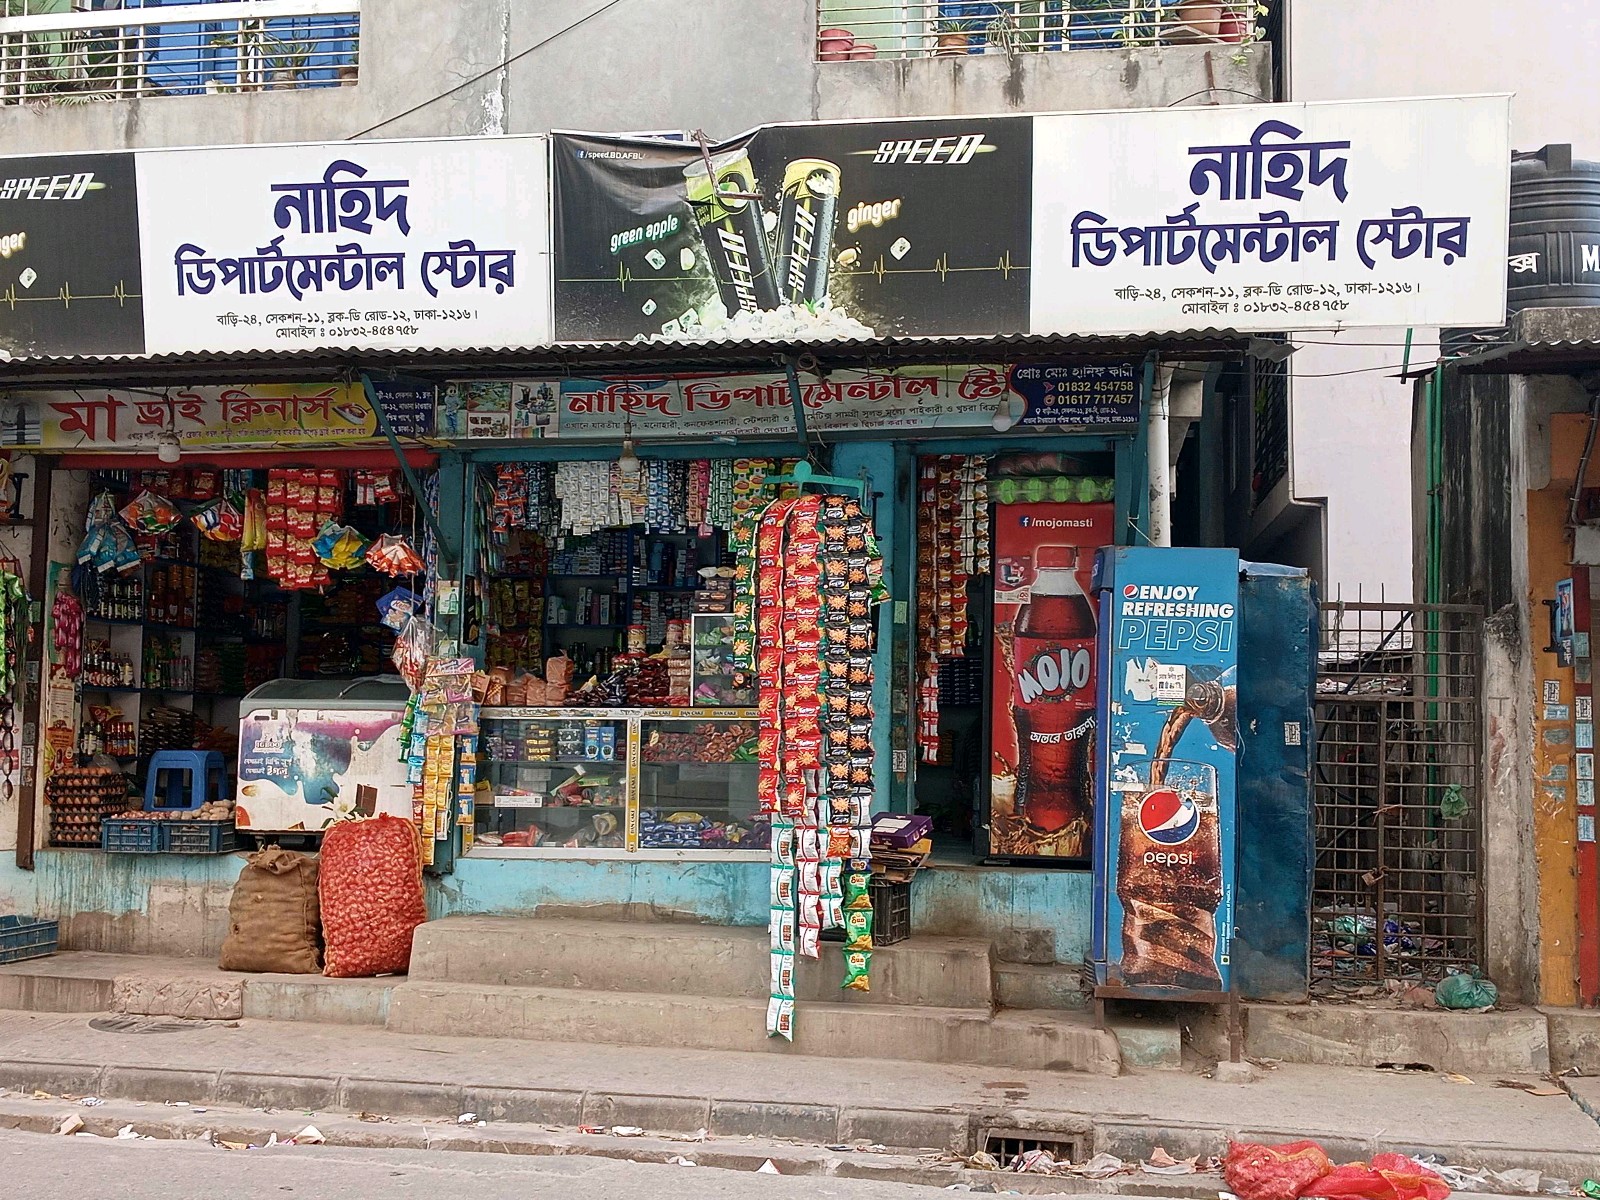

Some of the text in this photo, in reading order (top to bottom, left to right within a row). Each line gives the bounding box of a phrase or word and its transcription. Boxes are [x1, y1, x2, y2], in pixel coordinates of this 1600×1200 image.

[873, 133, 985, 164] SPEED
[1188, 120, 1351, 203] নাহিদ
[0, 172, 95, 200] SPEED
[270, 159, 411, 237] নাহিদ
[847, 198, 901, 232] ginger
[0, 231, 26, 259] ger
[610, 226, 643, 252] green
[646, 214, 679, 241] apple
[787, 203, 817, 294] SPEED
[1070, 202, 1470, 274] ডিপার্টমেন্টাল স্টোর
[174, 235, 516, 301] ডিপার্টমেন্টাল স্টোর
[1181, 300, 1228, 314] মোবাইল
[1243, 300, 1350, 314] ০১৮৩২-৪৫৪৭৫৮
[275, 326, 317, 338] মোবাইল
[329, 326, 419, 337] ০১৮৩২-৪৫৪৭৫৮
[566, 383, 682, 417] নাহিদ
[1057, 381, 1134, 392] 01832 454758
[1057, 394, 1134, 405] 01617 717457
[48, 387, 338, 443] মা ড্রাই ক্লিনার্স
[1139, 585, 1200, 600] ENJOY
[1122, 601, 1234, 618] REFRESHING
[1118, 618, 1233, 652] PEPSI
[1017, 648, 1091, 704] MOJO
[1030, 716, 1096, 743] অন্তরে তারুণ্য
[851, 915, 865, 924] Sun
